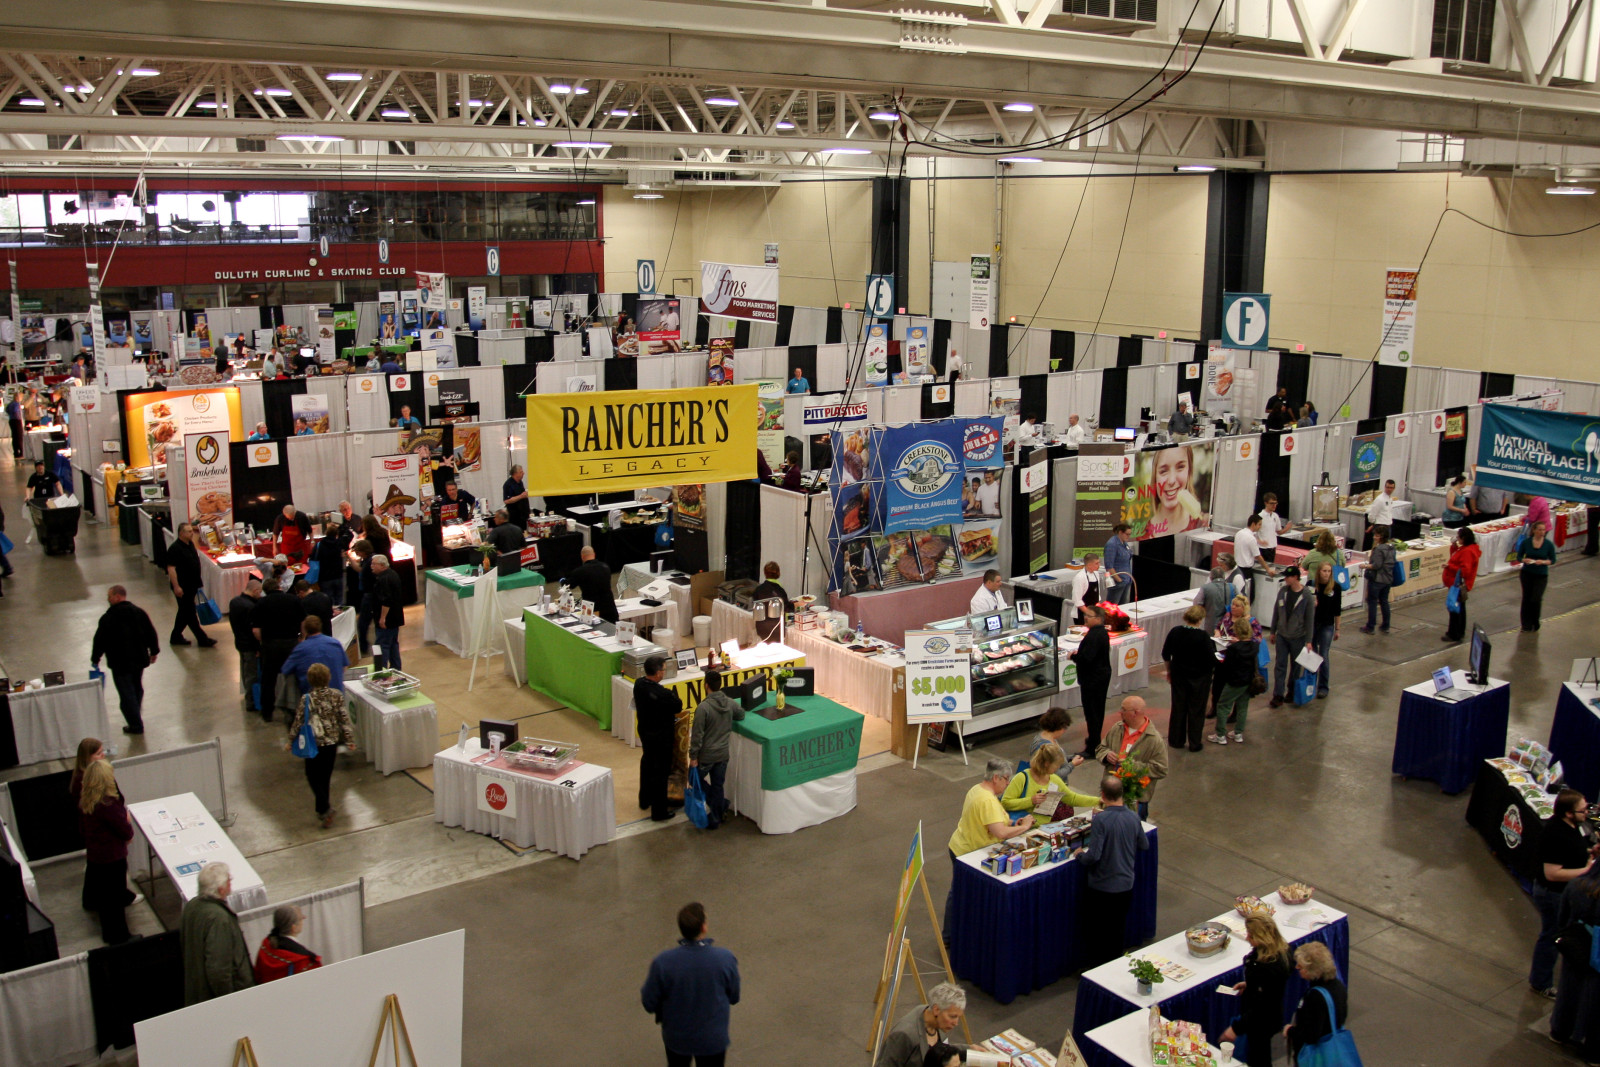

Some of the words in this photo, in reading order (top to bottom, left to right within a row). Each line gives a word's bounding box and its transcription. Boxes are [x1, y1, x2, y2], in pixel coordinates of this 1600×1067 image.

[215, 270, 259, 279] DULUTH
[265, 269, 310, 278] CURLING
[331, 268, 372, 276] SKATING
[379, 267, 406, 275] CLUB
[710, 269, 747, 305] fms
[876, 281, 884, 312] E
[747, 301, 775, 310] MARKETING
[752, 311, 775, 319] SERVICES
[1239, 301, 1253, 341] F
[560, 399, 729, 454] RANCHER'S
[966, 443, 995, 460] GRAZED
[1494, 433, 1552, 454] NATURAL
[578, 456, 711, 476] LEGACY
[903, 446, 949, 466] CREEKSTONE
[1487, 459, 1501, 467] Your
[1501, 463, 1526, 472] premier
[1493, 445, 1585, 471] MARKETPLACE
[425, 472, 430, 483] 5
[912, 675, 965, 696] $5,000
[779, 727, 856, 767] RANCHER'S
[486, 789, 506, 803] Local
